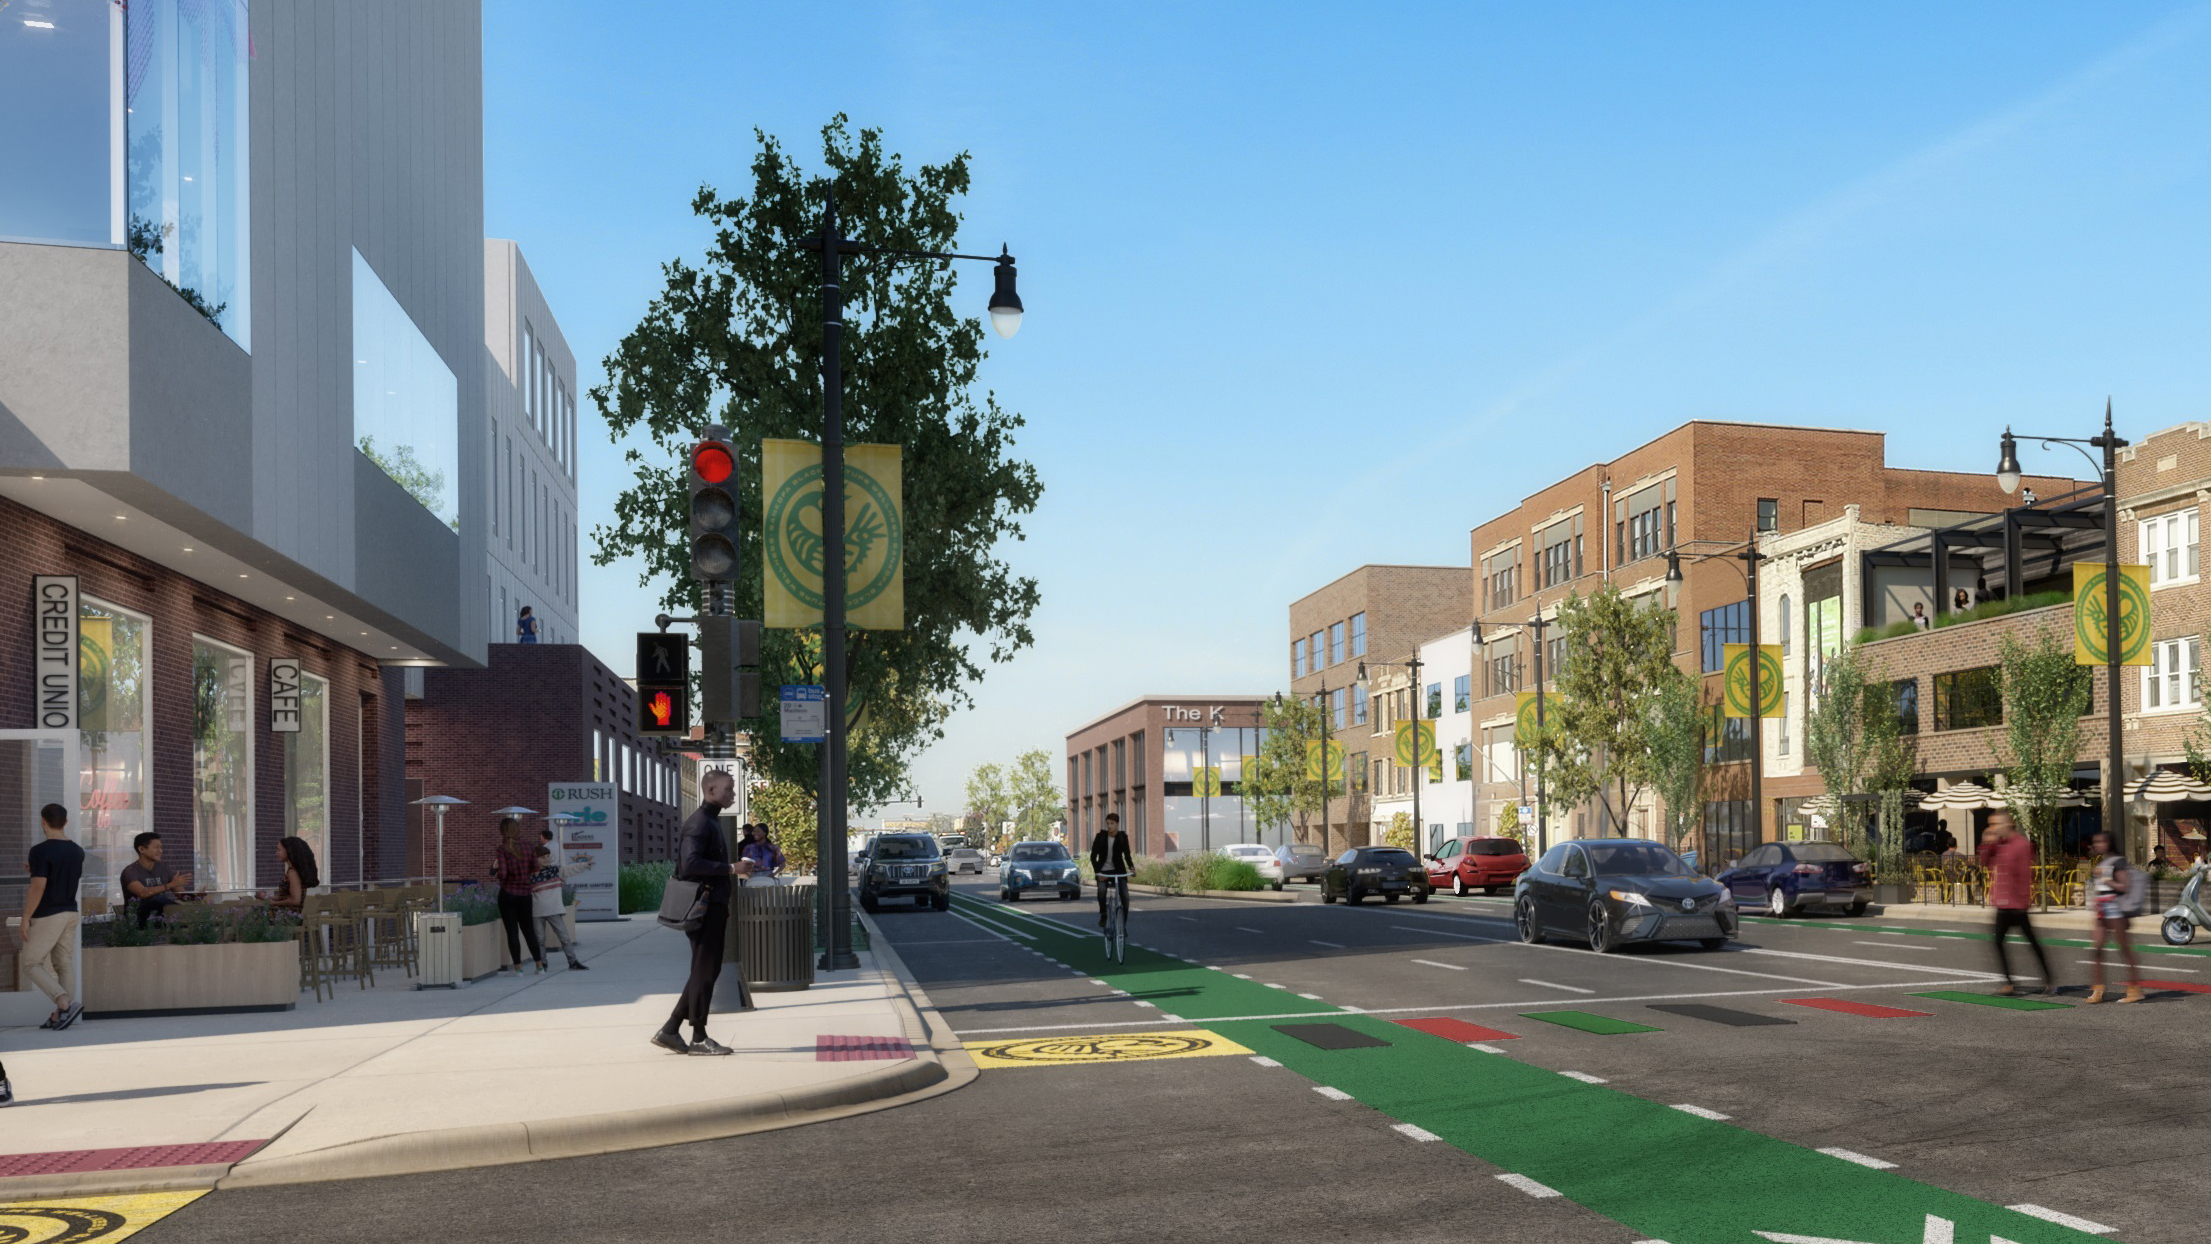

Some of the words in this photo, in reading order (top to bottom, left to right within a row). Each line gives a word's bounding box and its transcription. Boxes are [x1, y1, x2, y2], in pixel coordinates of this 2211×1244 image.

[42, 583, 69, 666] CREDIT
[42, 674, 69, 729] UNIO
[272, 664, 299, 723] CAFE
[1162, 705, 1201, 721] The
[1209, 705, 1225, 721] K
[567, 788, 613, 800] RUSH
